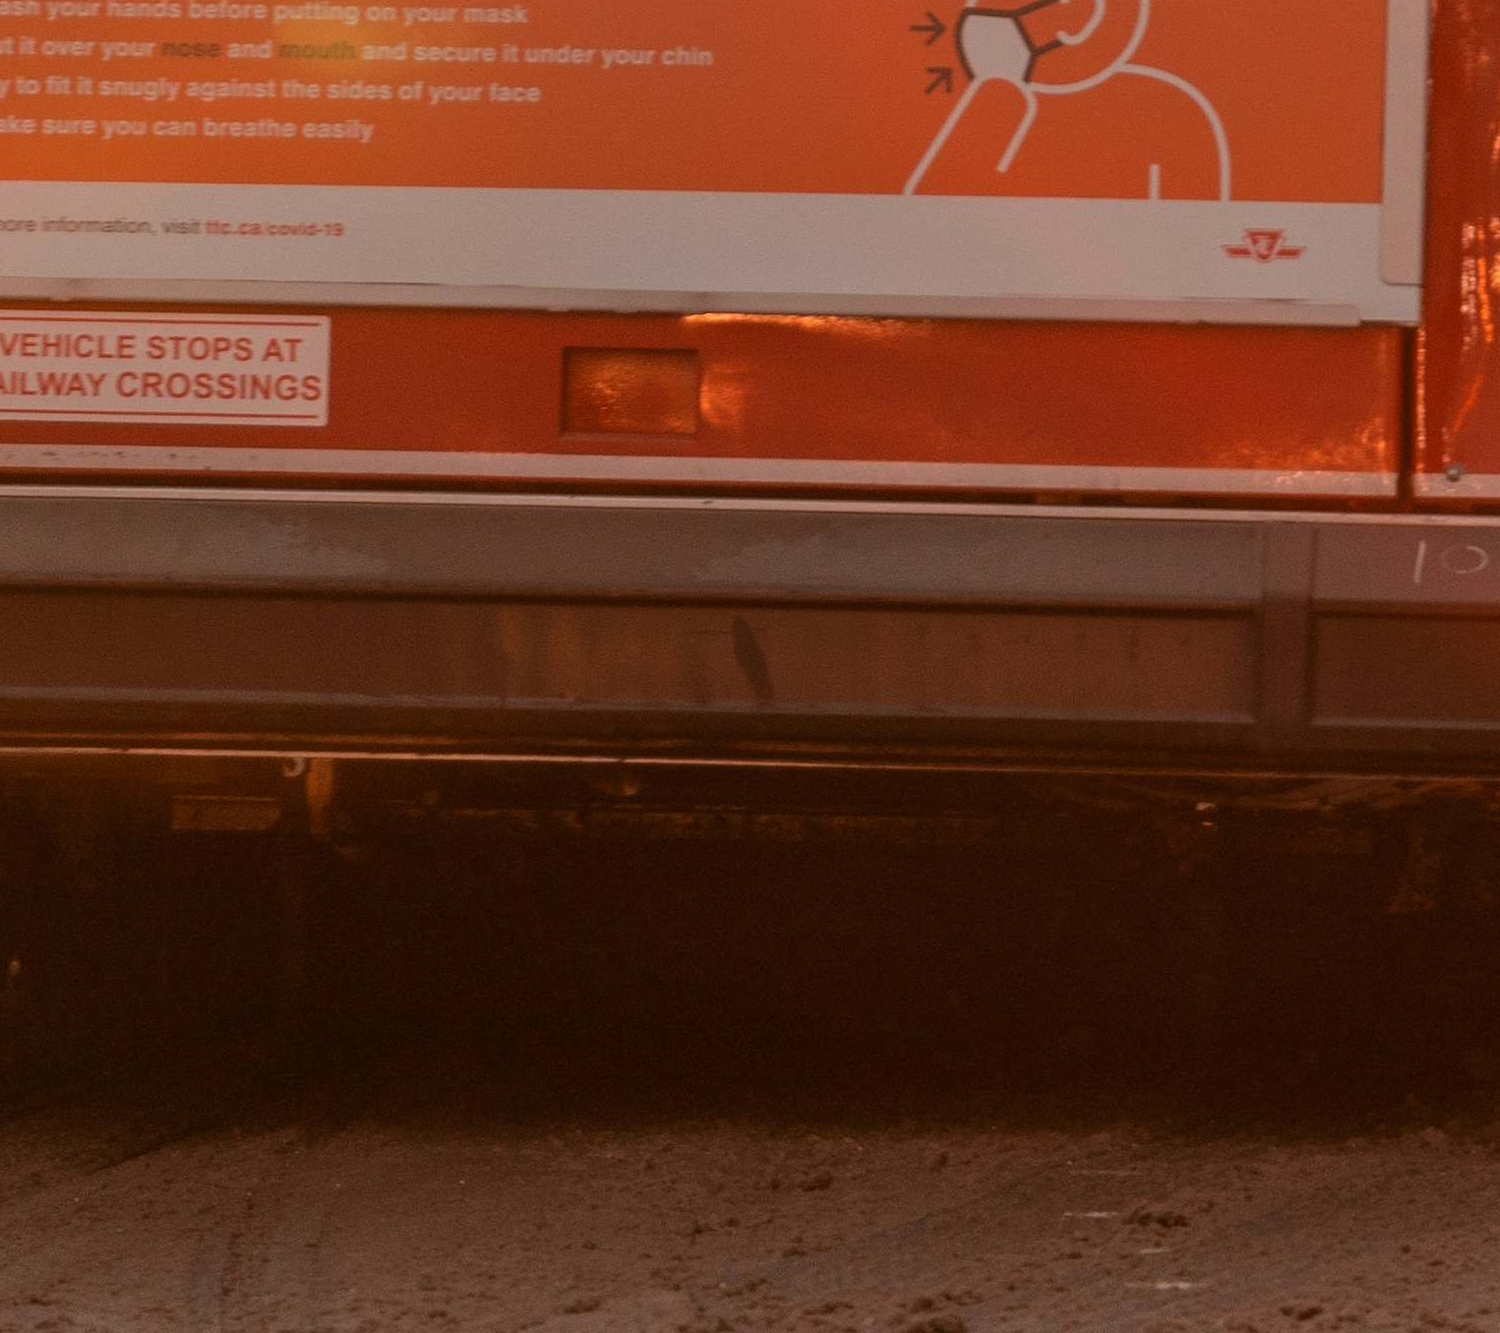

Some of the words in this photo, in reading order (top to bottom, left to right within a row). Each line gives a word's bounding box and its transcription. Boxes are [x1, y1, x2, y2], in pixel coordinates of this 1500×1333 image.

[46, 1, 101, 21] your
[272, 0, 360, 26] putting
[366, 6, 397, 22] on
[402, 7, 458, 27] your
[463, 4, 528, 25] mask
[19, 36, 36, 56] it
[41, 41, 96, 57] over
[100, 41, 156, 62] your
[160, 42, 221, 58] nose
[227, 40, 273, 59] and
[279, 40, 356, 60] mouth
[361, 42, 407, 62] and
[414, 46, 497, 63] secure
[502, 43, 519, 63] it
[525, 44, 595, 65] under
[602, 49, 656, 70] your
[661, 46, 714, 67] chin
[16, 77, 41, 95] to
[46, 75, 71, 95] fit
[76, 75, 94, 95] it
[99, 78, 181, 102] snugly
[186, 79, 277, 103] against
[282, 80, 321, 99] the
[327, 80, 392, 100] sides
[399, 81, 426, 100] of
[429, 85, 483, 106] your
[488, 82, 541, 103] face
[42, 118, 97, 135] sure
[102, 119, 147, 141] you
[151, 120, 197, 137] can
[202, 116, 297, 138] breathe
[302, 119, 374, 143] easily
[41, 216, 155, 237] information,
[162, 218, 201, 236] visit
[146, 335, 252, 363] STOPS
[260, 338, 303, 364] AT
[116, 372, 322, 402] CROSSINGS
